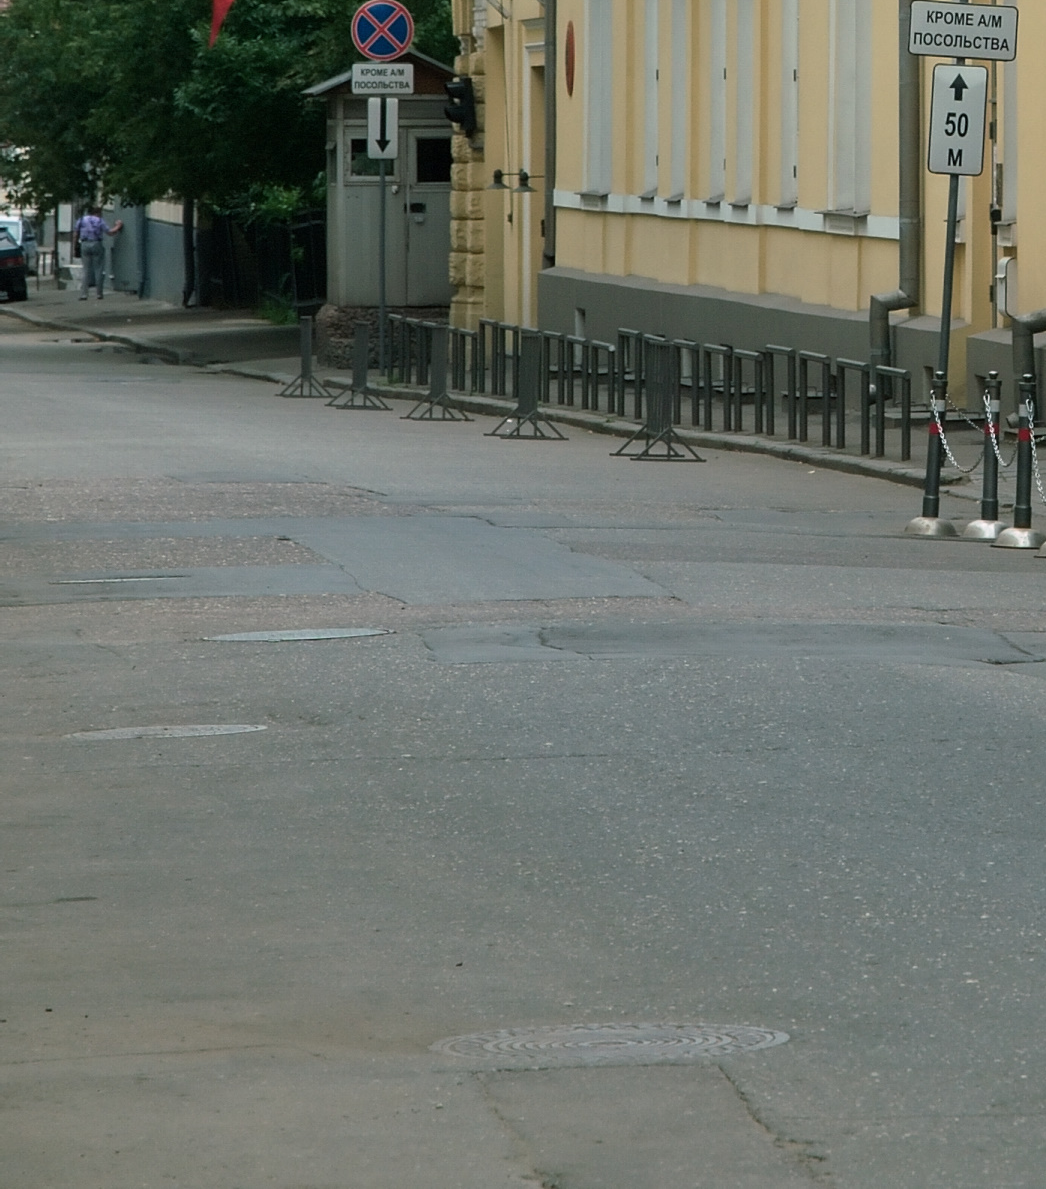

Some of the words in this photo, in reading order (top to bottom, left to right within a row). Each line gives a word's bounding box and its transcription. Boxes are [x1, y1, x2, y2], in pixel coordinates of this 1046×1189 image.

[926, 10, 974, 27] КРОМЕ
[977, 14, 1003, 29] А/М
[913, 32, 1010, 52] ПОСОЛЬСТВА
[361, 68, 388, 77] КРОМЕ
[390, 68, 404, 77] А/М
[354, 81, 410, 89] ПОСОЛЬСТВА
[944, 112, 969, 138] 50
[947, 148, 963, 167] М
